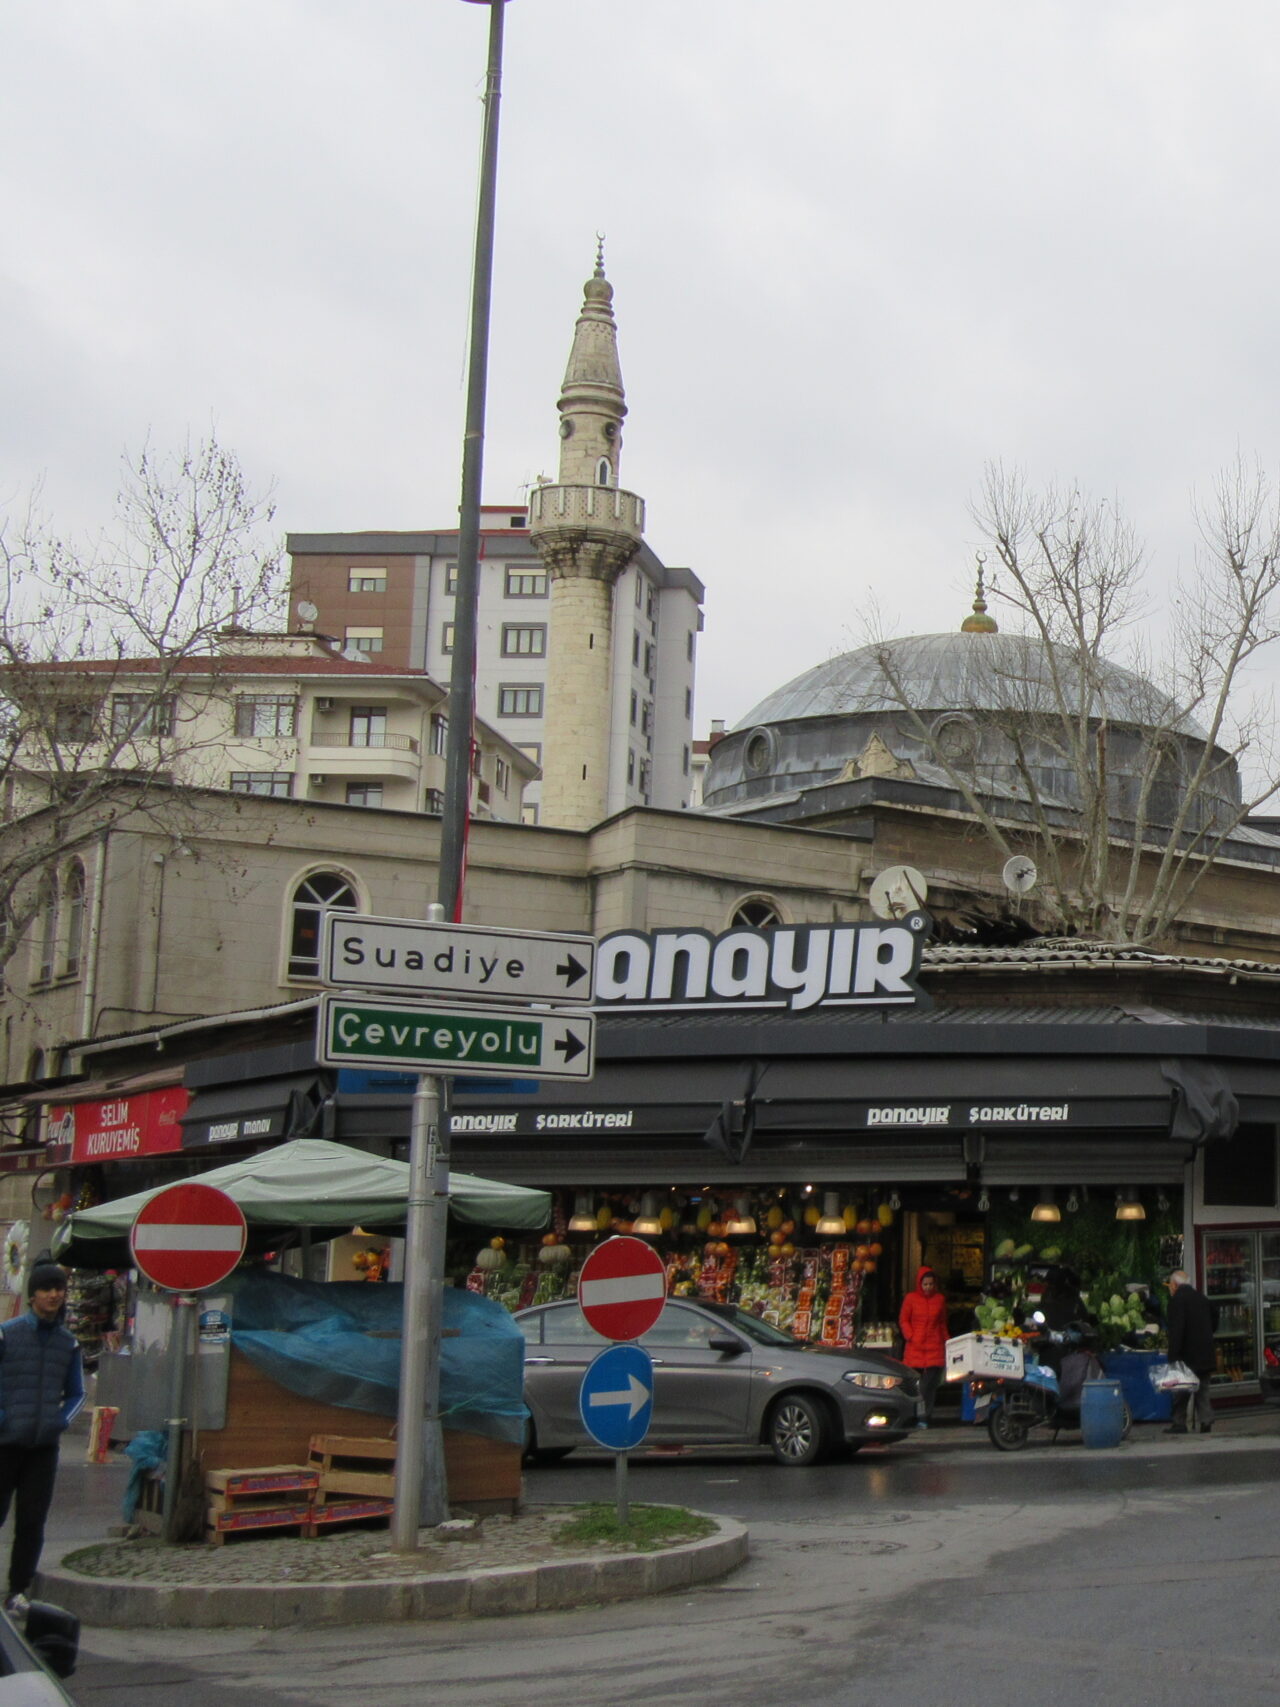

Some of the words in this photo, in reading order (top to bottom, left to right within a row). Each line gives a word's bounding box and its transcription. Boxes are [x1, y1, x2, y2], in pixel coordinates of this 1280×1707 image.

[342, 937, 525, 984] Suadiye
[338, 1013, 538, 1058] Çevreyolu
[101, 1098, 128, 1127] SELİM
[87, 1122, 140, 1156] KURUYEMİŞ
